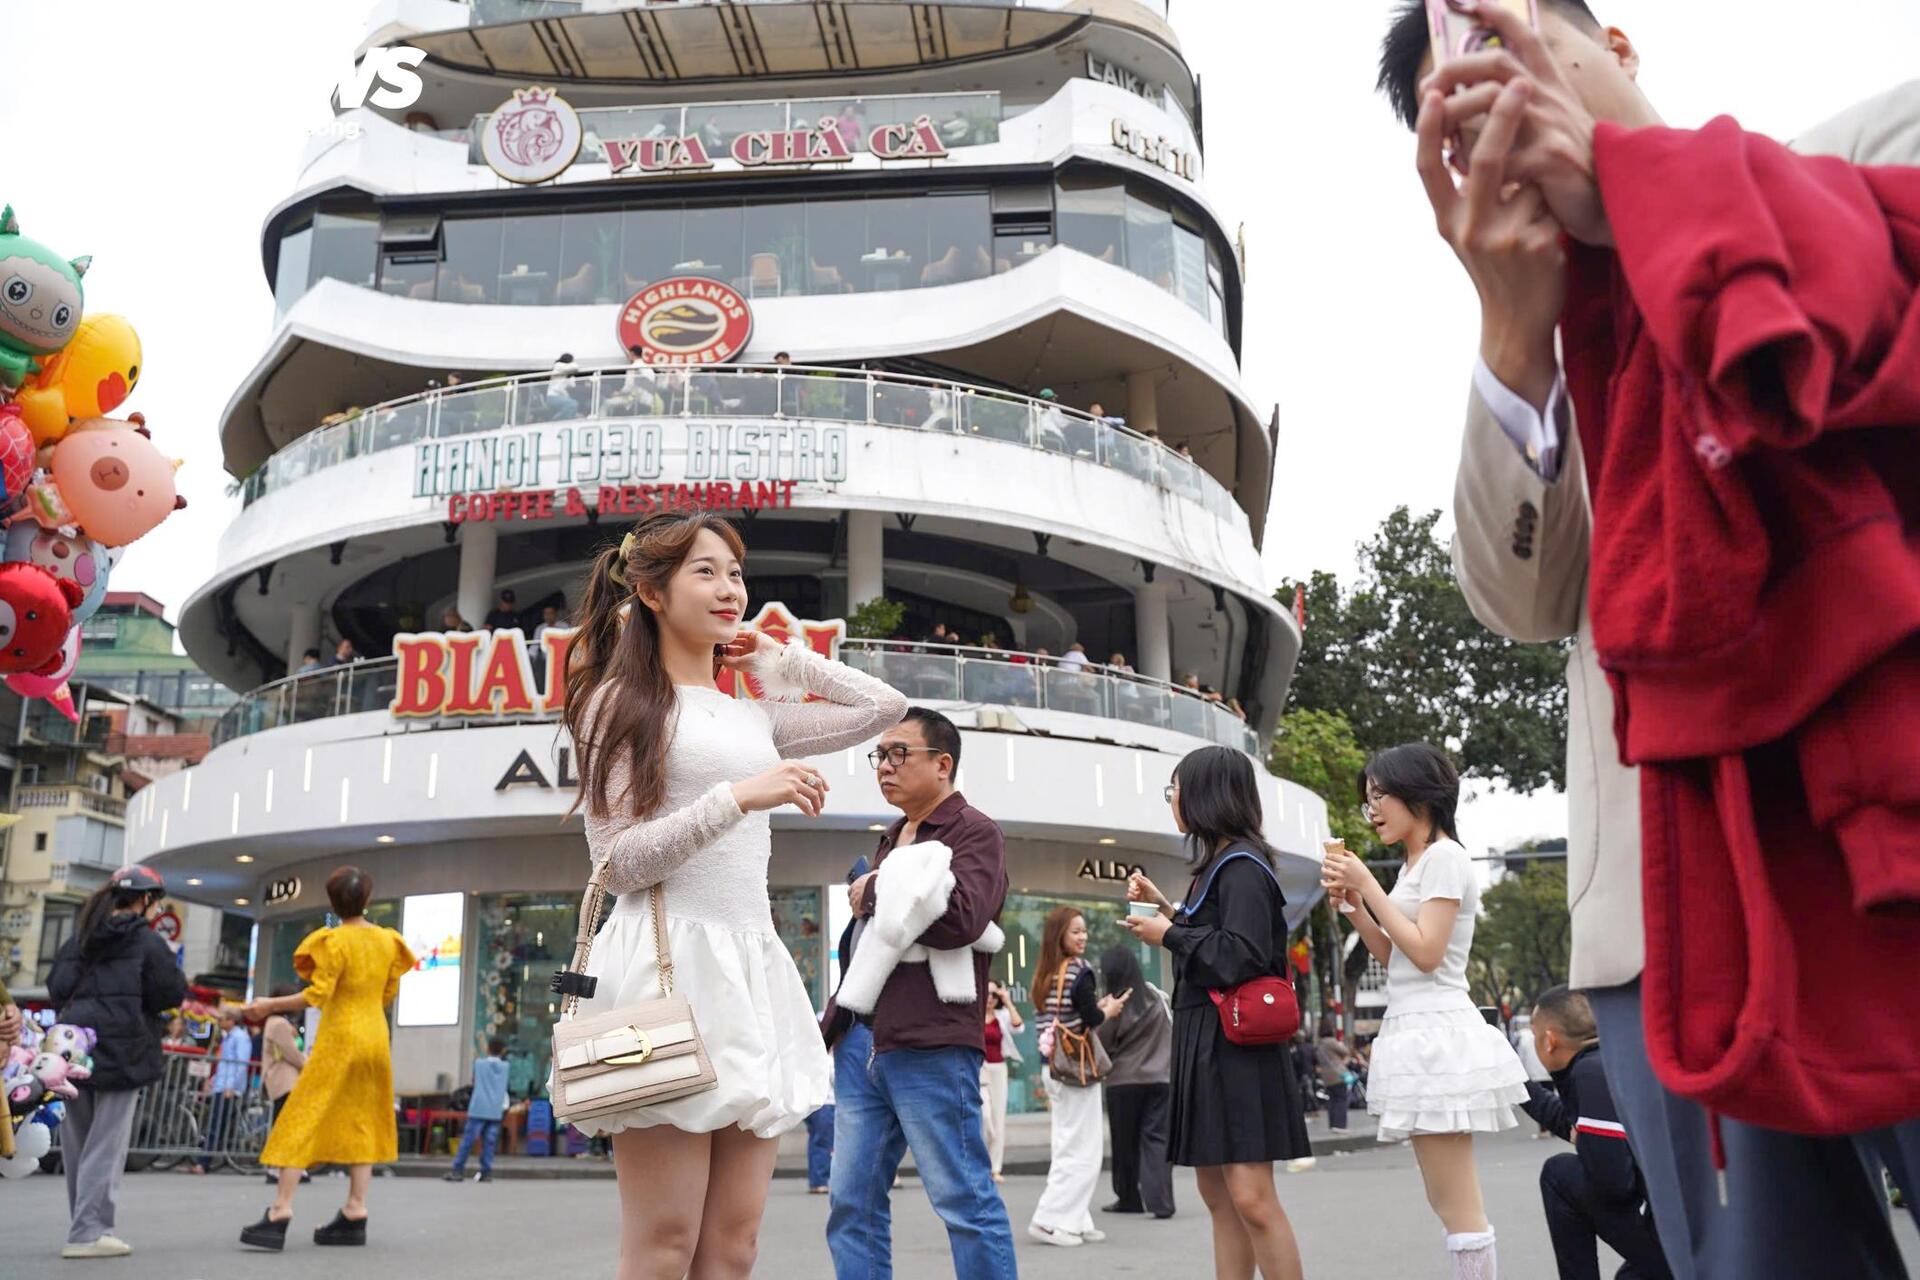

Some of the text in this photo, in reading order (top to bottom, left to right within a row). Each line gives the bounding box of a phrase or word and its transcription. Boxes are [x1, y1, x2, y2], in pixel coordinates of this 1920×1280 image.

[601, 114, 948, 172] VUA CHẢ CÁ
[624, 282, 745, 324] HIGHLANDS
[414, 424, 848, 497] HANOI 1930 BISTRO
[448, 481, 797, 524] COFFEE & RESTAURANT
[392, 633, 534, 716] BIA
